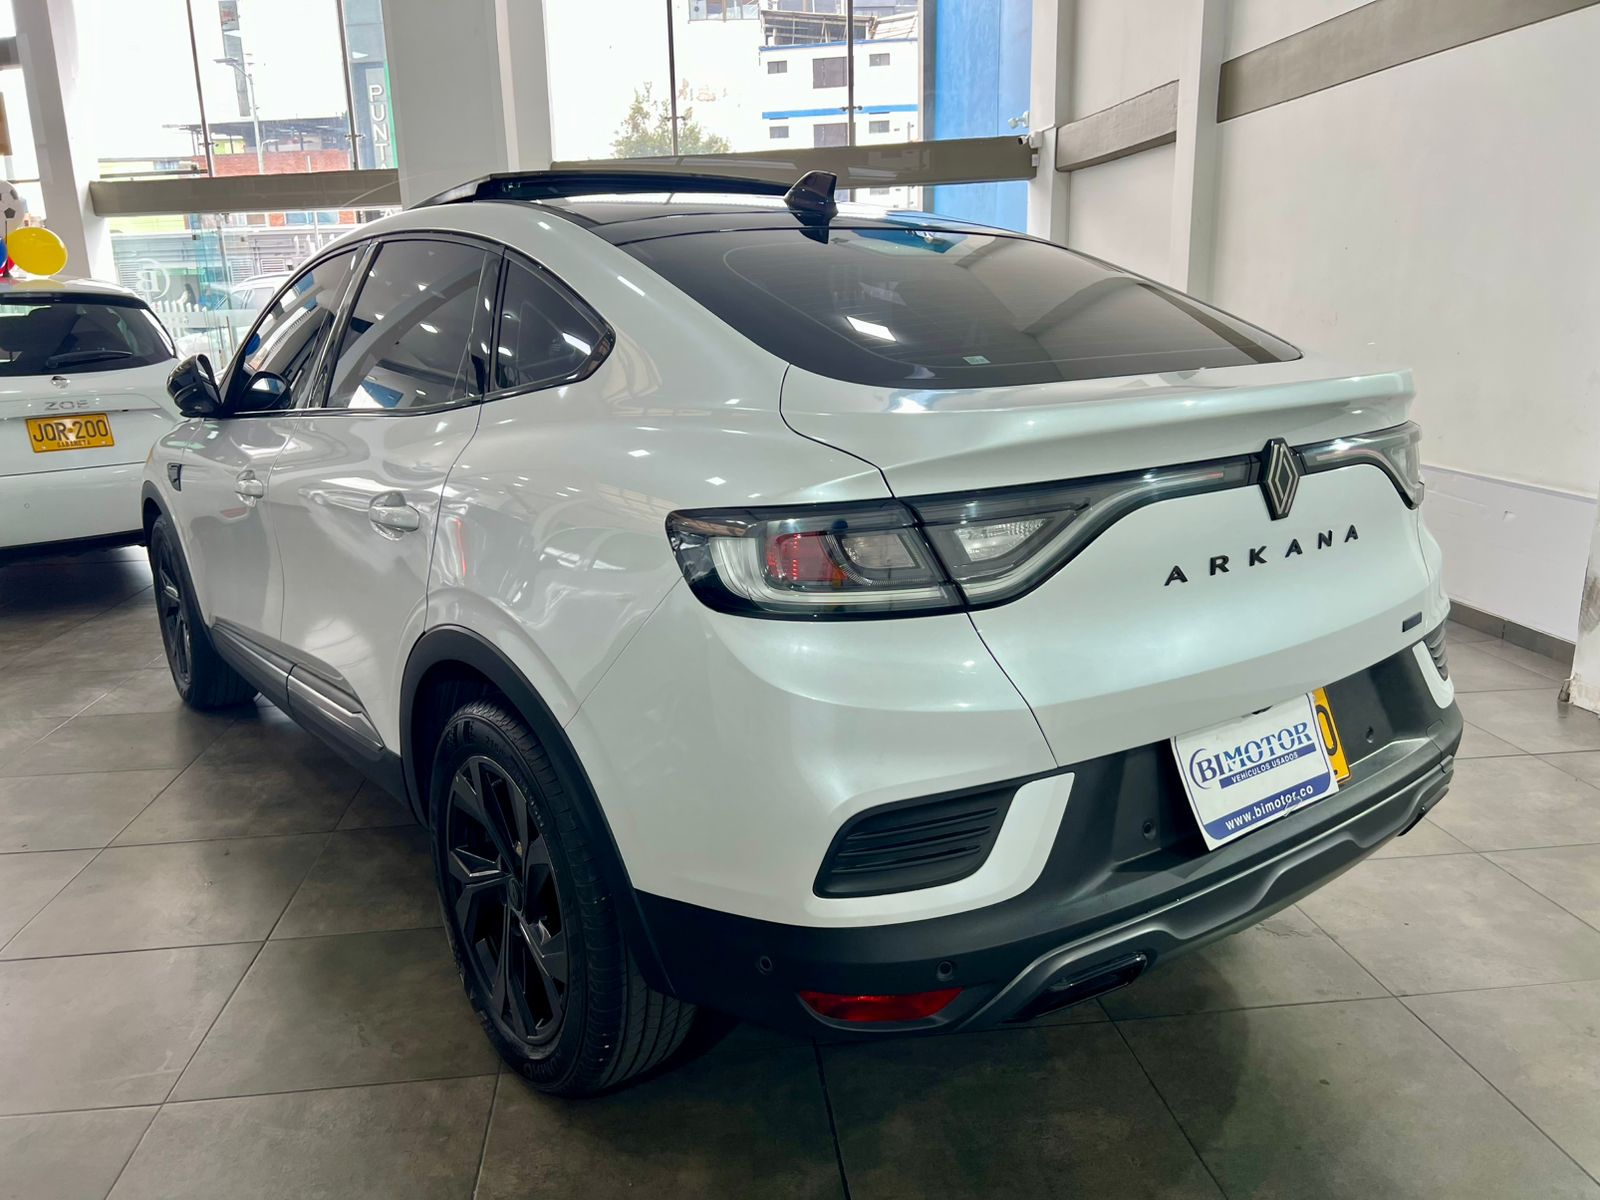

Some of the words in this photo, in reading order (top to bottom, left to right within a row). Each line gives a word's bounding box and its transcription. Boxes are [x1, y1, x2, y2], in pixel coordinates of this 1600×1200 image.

[44, 400, 89, 411] ZOE
[1164, 524, 1359, 587] ARKANA
[1193, 721, 1312, 785] BIMOTOR
[1272, 751, 1299, 768] USADOS
[1225, 785, 1314, 831] www.bimotor.co
